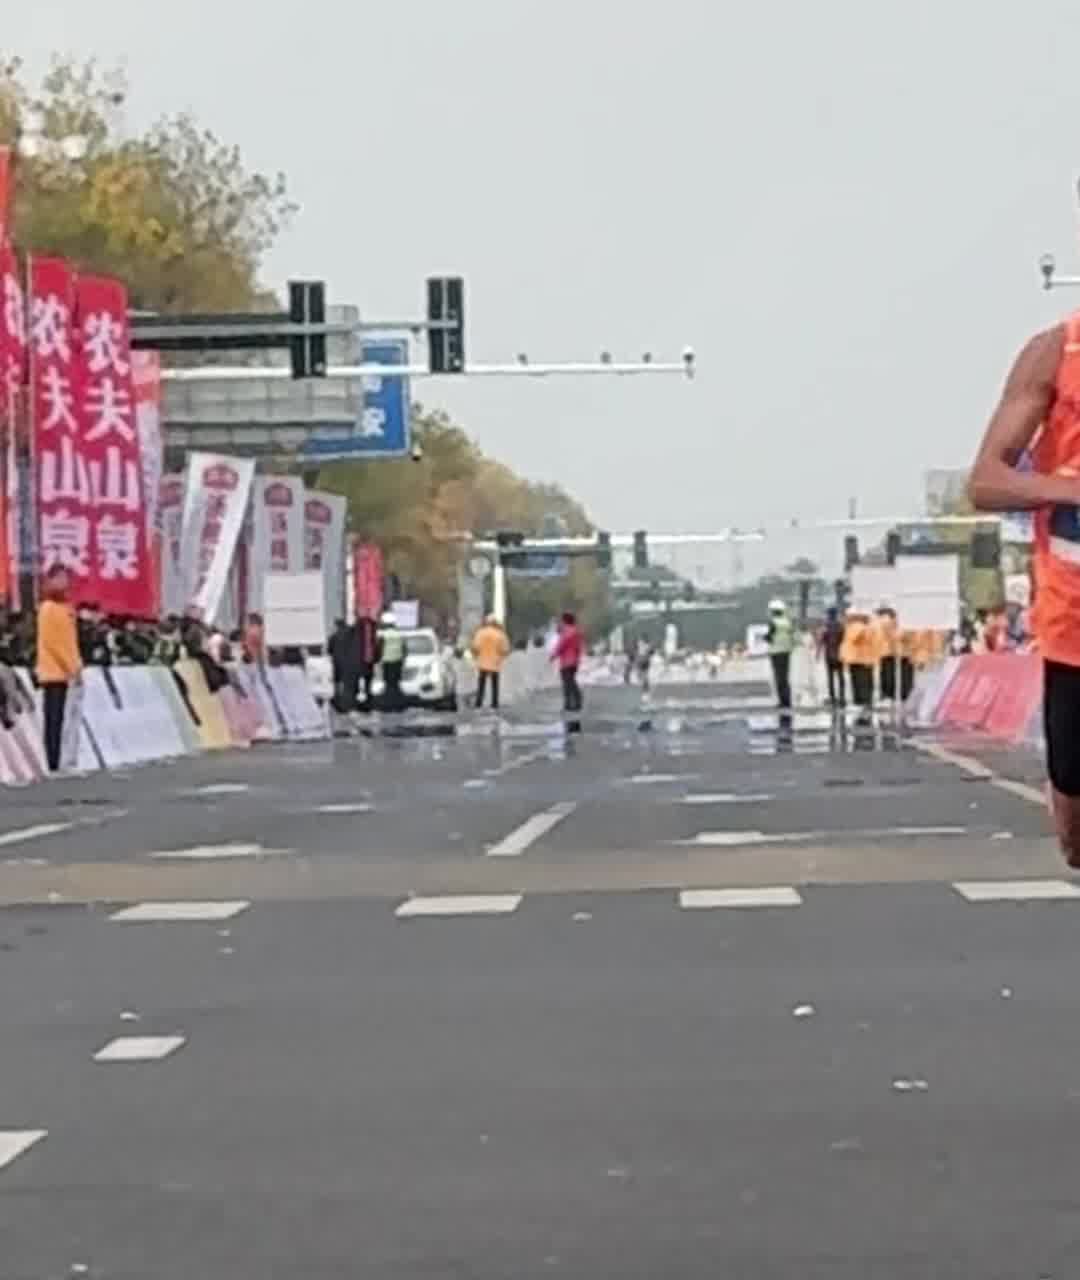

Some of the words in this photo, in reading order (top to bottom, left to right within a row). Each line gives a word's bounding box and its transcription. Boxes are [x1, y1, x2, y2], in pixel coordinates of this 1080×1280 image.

[32, 293, 90, 578] 农夫山泉
[83, 311, 140, 580] 农夫山泉
